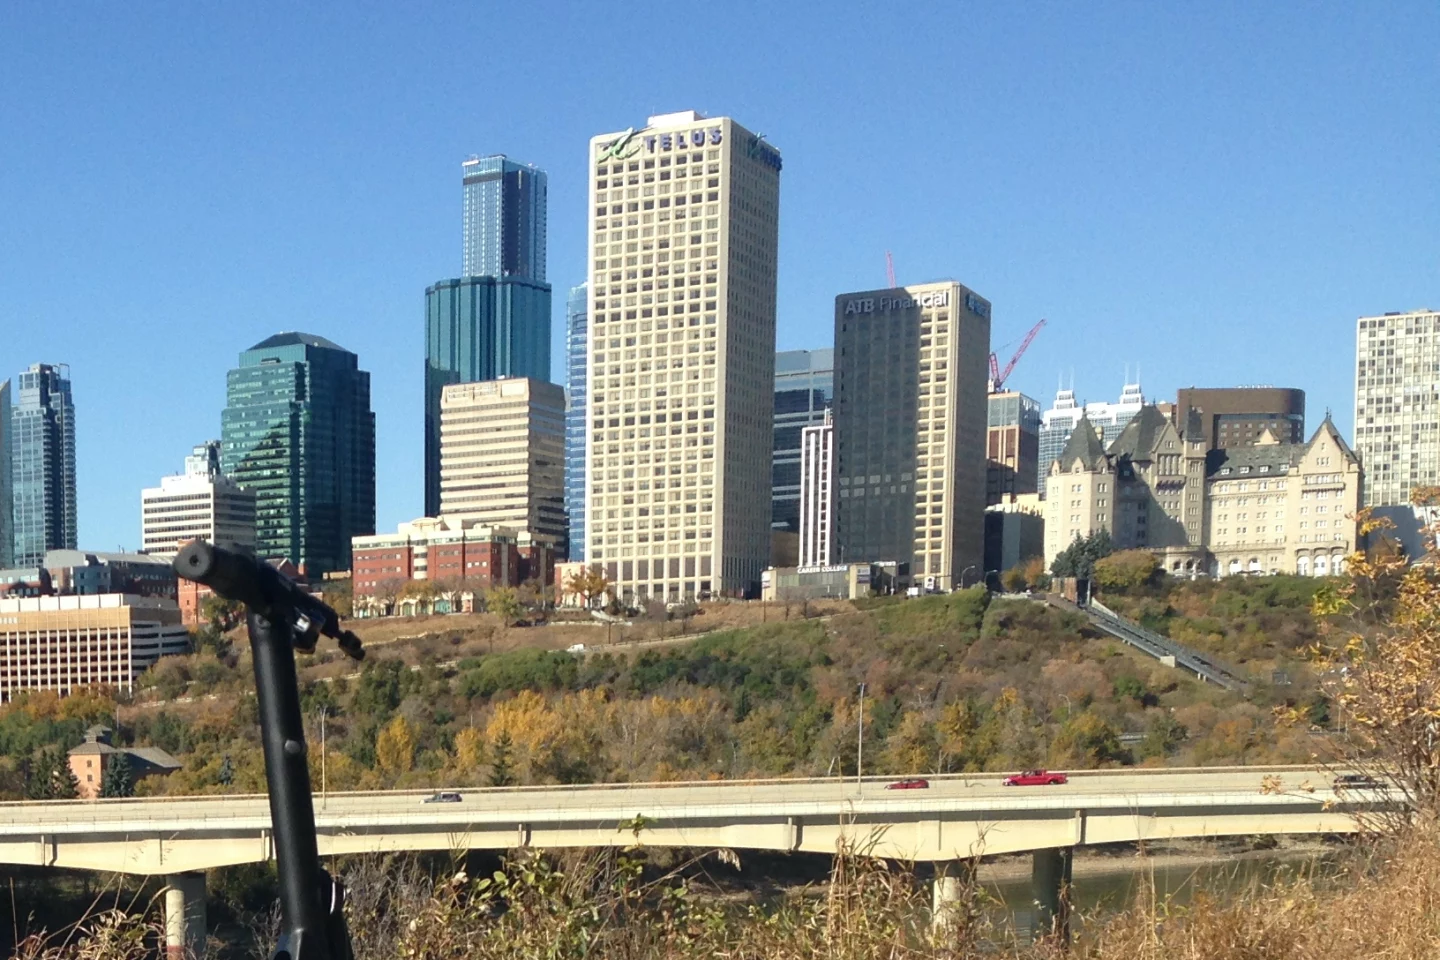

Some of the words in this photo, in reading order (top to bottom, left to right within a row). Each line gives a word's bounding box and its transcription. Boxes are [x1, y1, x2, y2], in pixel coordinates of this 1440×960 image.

[644, 127, 722, 153] TELUS
[845, 298, 874, 315] ATB
[879, 292, 948, 310] Financial
